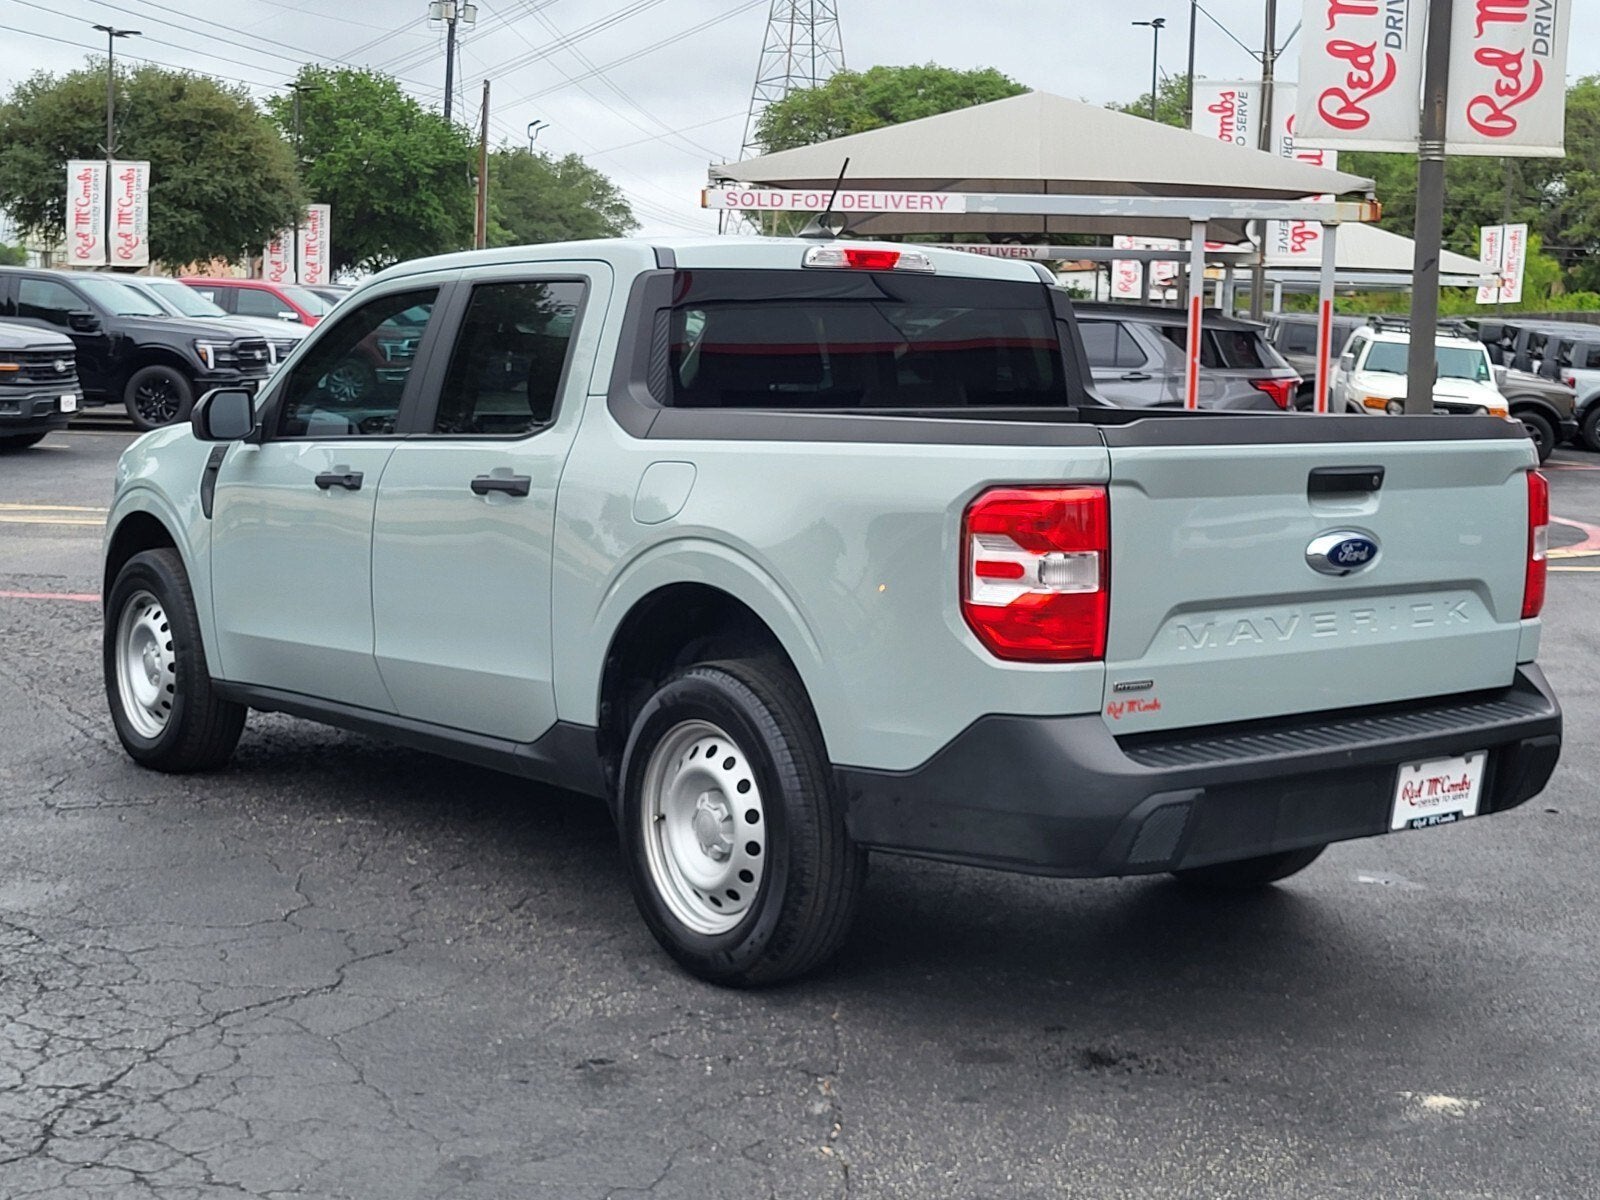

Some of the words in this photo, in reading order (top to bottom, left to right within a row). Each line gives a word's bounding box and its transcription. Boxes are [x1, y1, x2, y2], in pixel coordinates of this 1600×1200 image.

[1384, 0, 1404, 50] DRI
[1532, 0, 1552, 56] DRIV
[1317, 39, 1397, 131] Red
[1467, 47, 1543, 138] Red
[1208, 91, 1236, 143] ombs
[1236, 91, 1248, 132] SERVE
[1235, 136, 1246, 147] O
[1283, 136, 1293, 159] DRI
[75, 168, 92, 229] McCombs
[92, 193, 99, 203] TO
[118, 168, 135, 229] McCombs
[135, 193, 142, 203] TO
[725, 192, 784, 208] SOLD
[791, 193, 833, 209] FOR
[842, 194, 949, 211] DELIVERY
[75, 232, 96, 258] Red
[117, 232, 139, 259] Red
[969, 246, 1038, 258] DELIVERY
[1278, 220, 1289, 253] ERVE
[1338, 542, 1369, 562] Ford
[1177, 600, 1469, 649] MAVERICK
[1402, 780, 1423, 806] Red
[1427, 774, 1470, 795] McCombs
